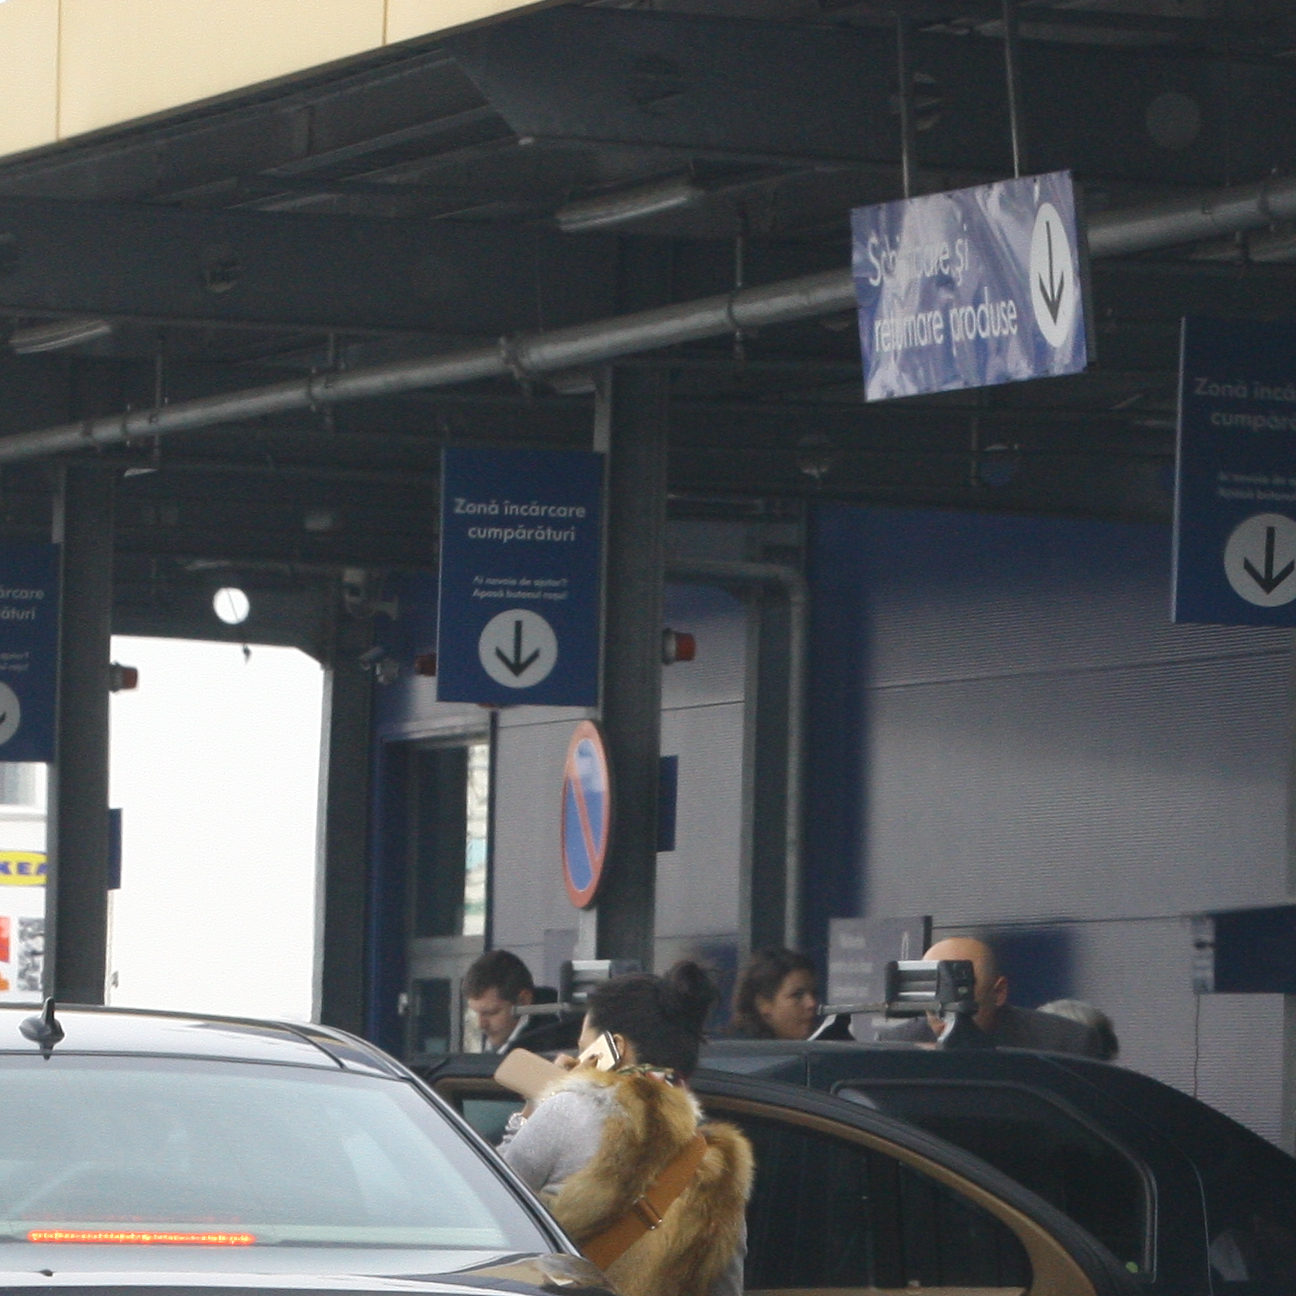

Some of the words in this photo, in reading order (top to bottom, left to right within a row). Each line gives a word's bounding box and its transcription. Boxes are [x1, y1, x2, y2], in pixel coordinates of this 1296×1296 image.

[949, 285, 1018, 357] produse
[1193, 377, 1248, 398] Zonă
[454, 497, 499, 515] Zonă
[503, 500, 586, 518] încărcare
[467, 525, 575, 543] cumpărături
